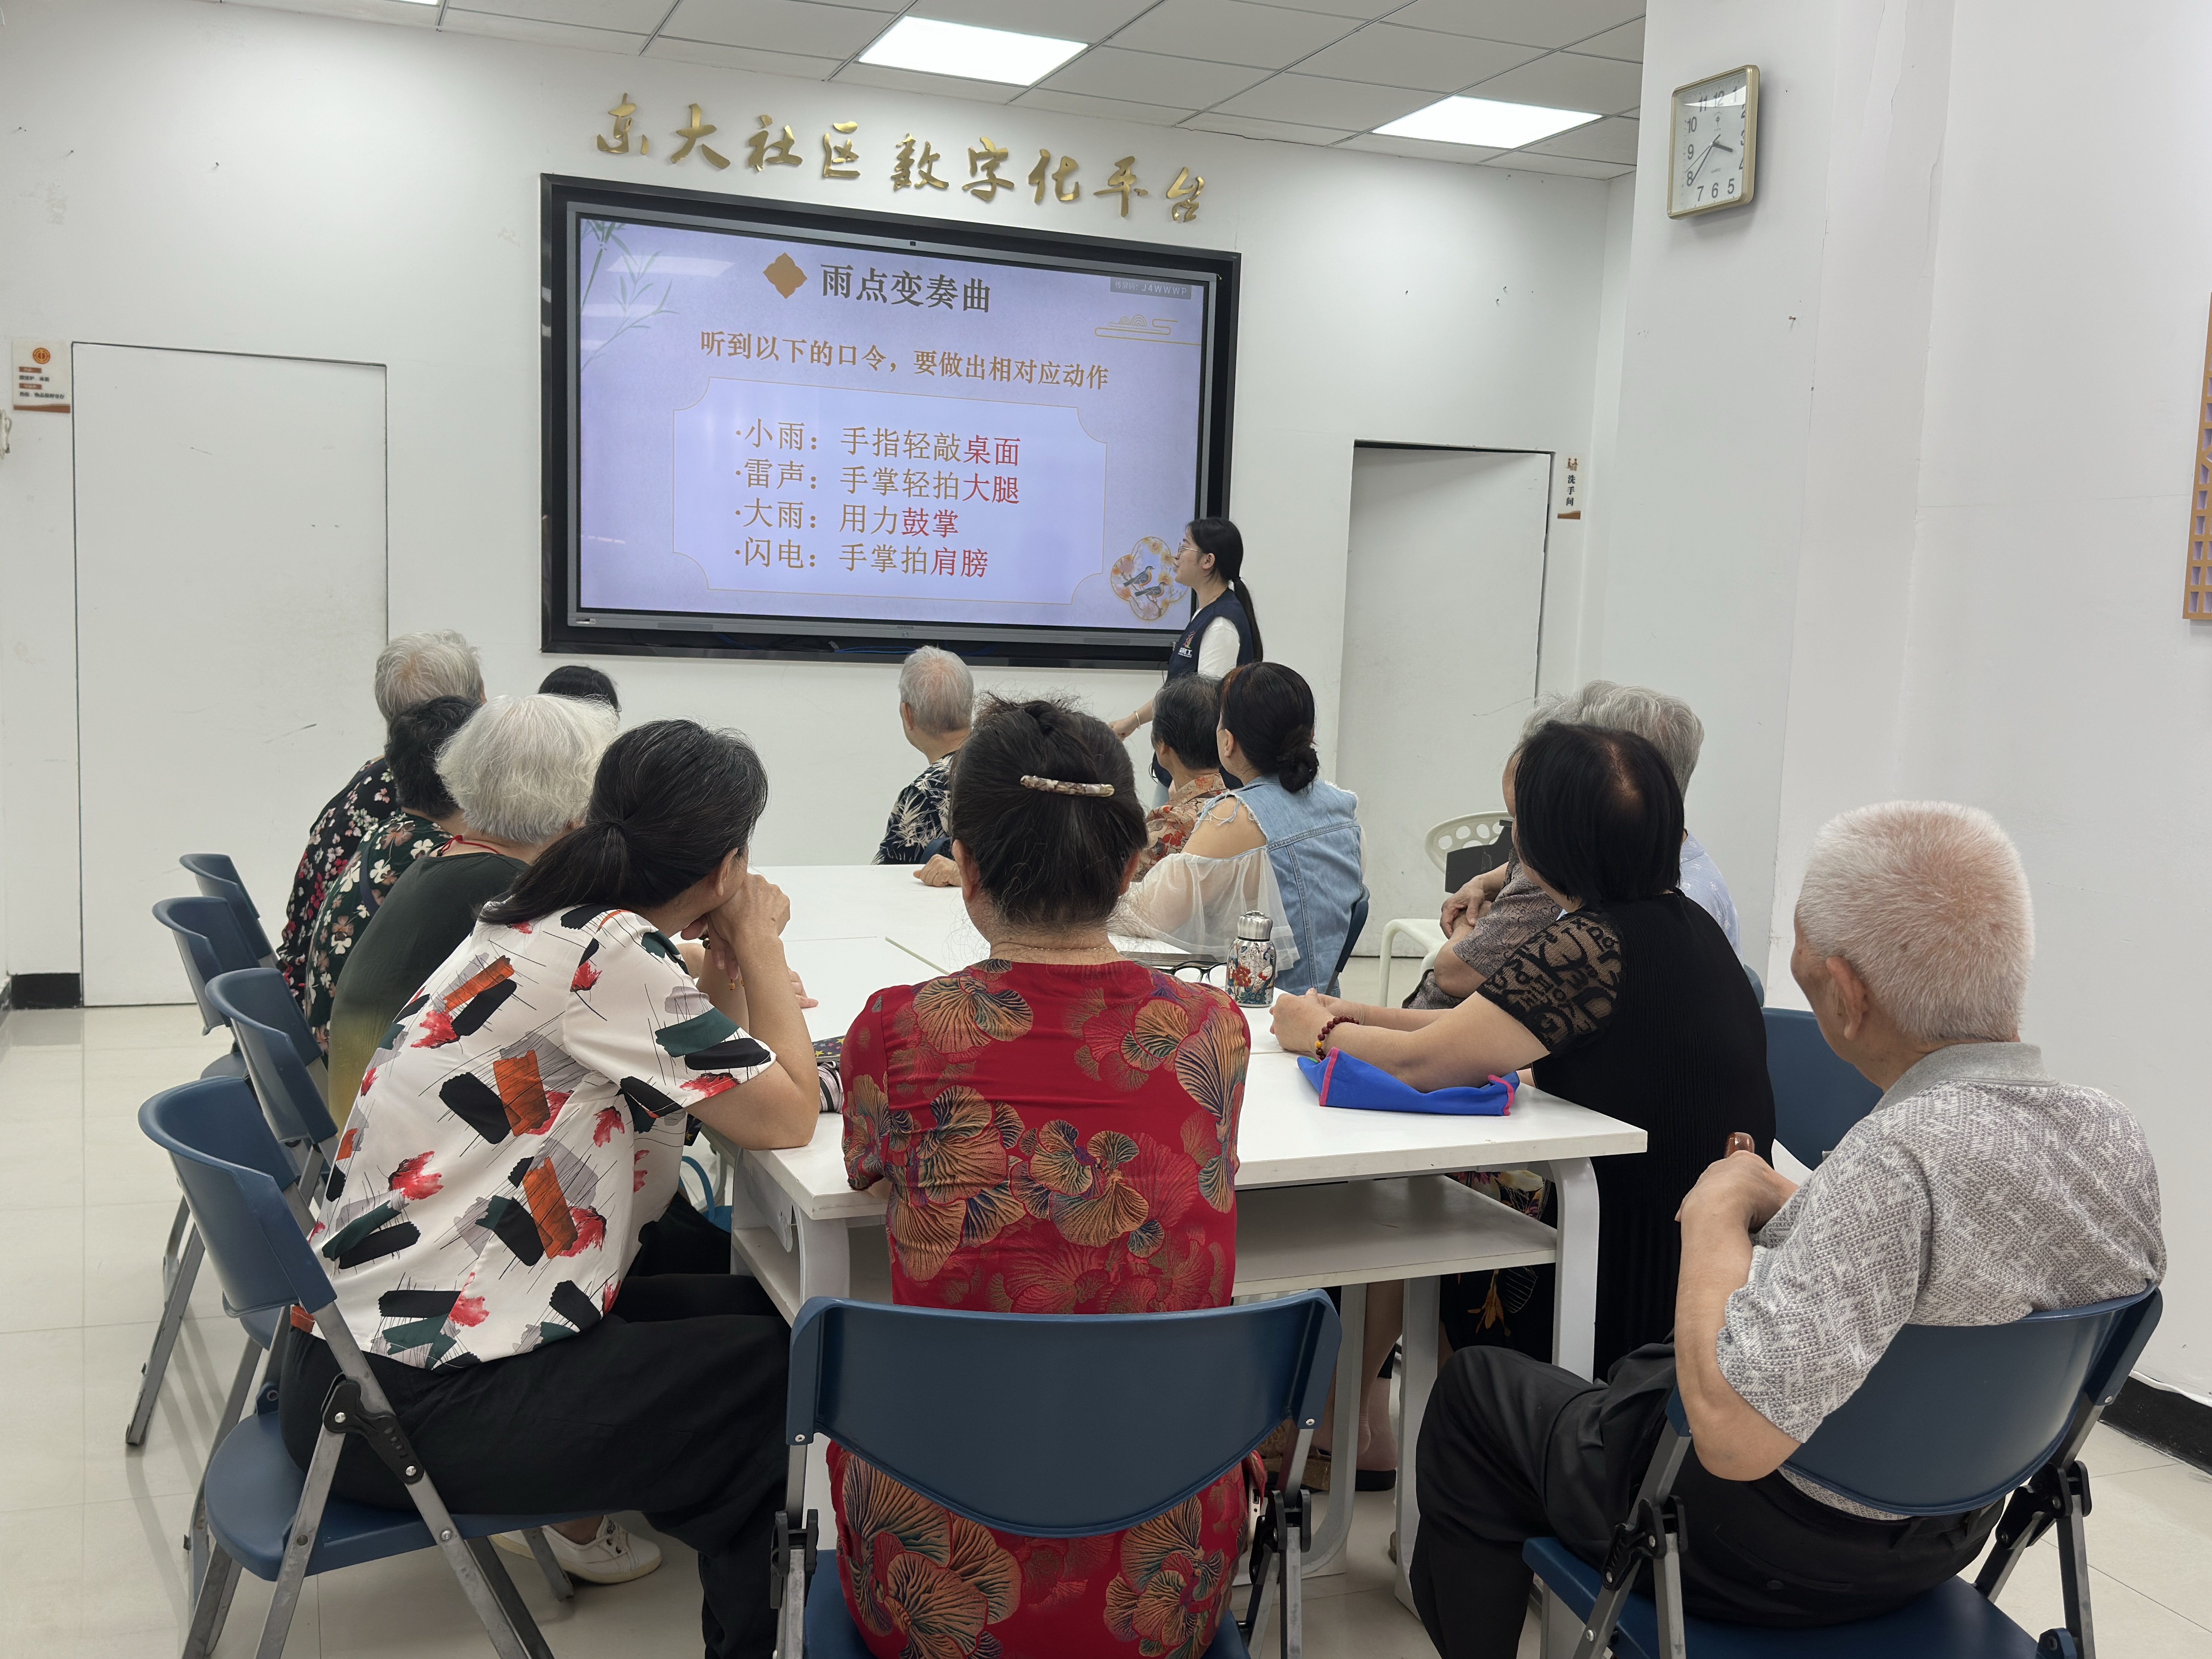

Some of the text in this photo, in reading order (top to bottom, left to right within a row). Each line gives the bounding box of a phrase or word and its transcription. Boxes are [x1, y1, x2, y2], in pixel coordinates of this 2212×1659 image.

[1698, 95, 1708, 113] 11
[1713, 90, 1725, 108] 12
[1687, 116, 1697, 133] 10
[1688, 144, 1694, 160] 9
[1686, 170, 1694, 187] 8
[1727, 178, 1735, 195] 5
[1697, 185, 1704, 202] 7
[1711, 182, 1719, 199] 6
[821, 264, 990, 313] 雨点变奏曲
[1566, 474, 1575, 506] 洗手间
